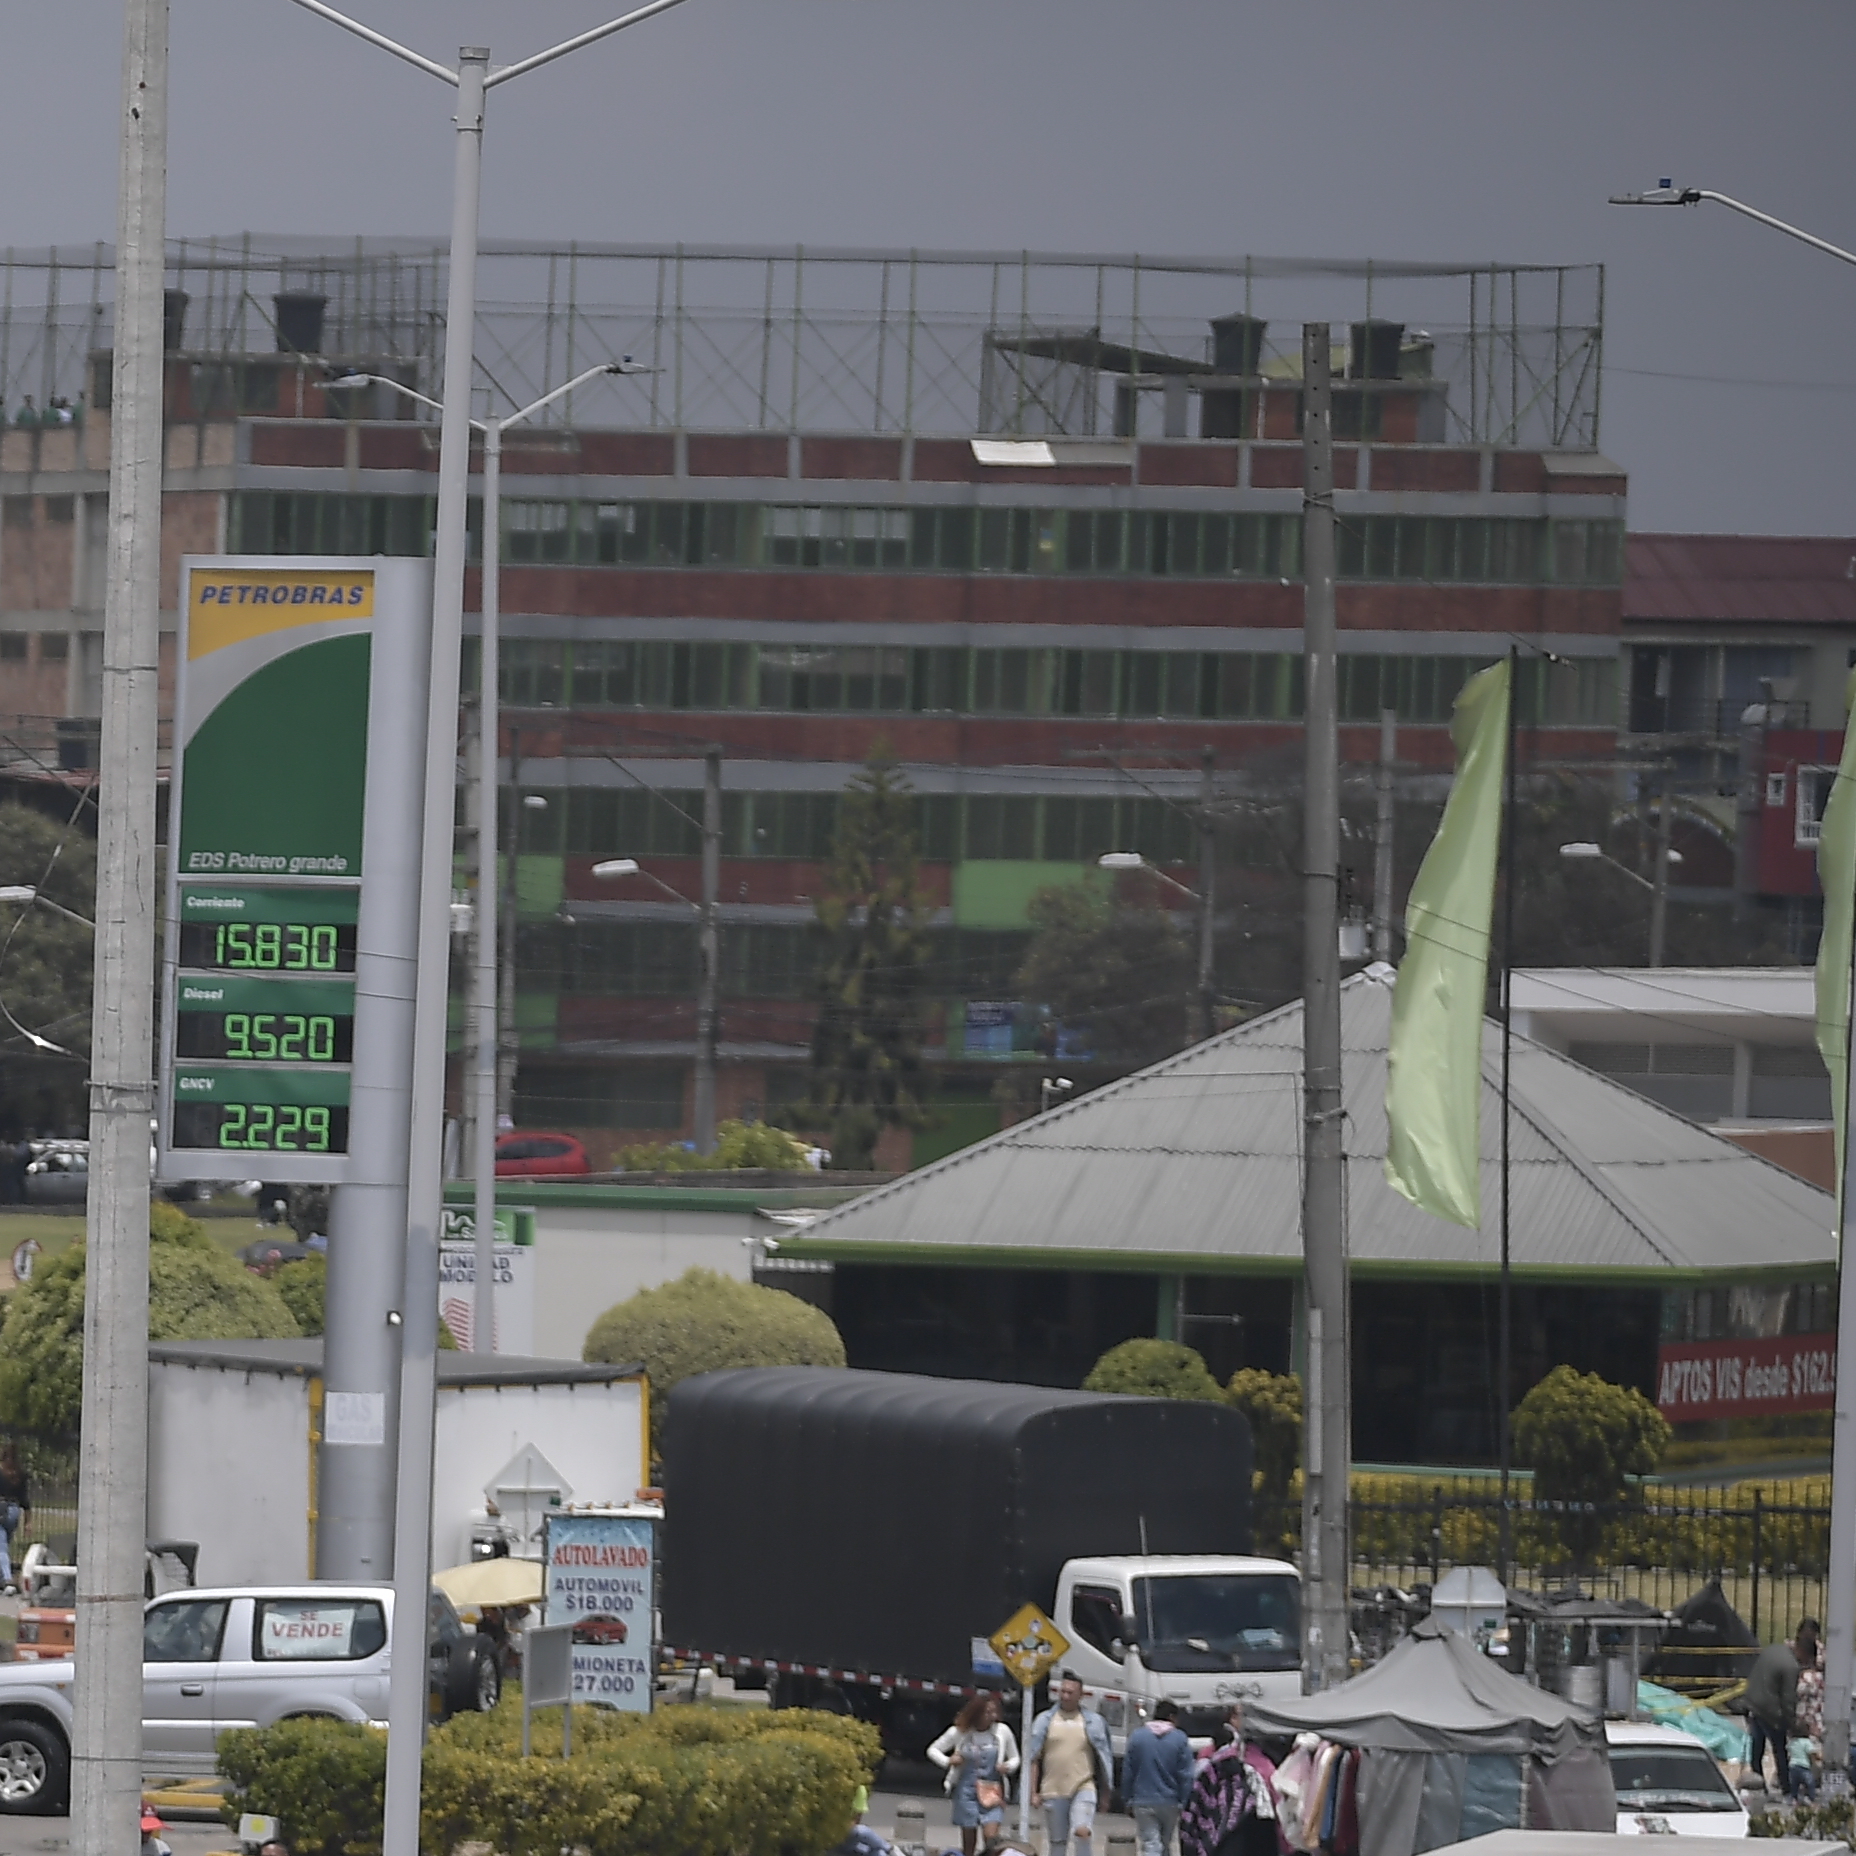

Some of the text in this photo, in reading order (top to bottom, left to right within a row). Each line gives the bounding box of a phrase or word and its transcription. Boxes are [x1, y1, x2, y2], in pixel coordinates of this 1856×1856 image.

[200, 586, 365, 604] PETROBRAS
[190, 852, 348, 874] EDS Potrero grande
[183, 987, 225, 999] Diesel
[442, 1257, 511, 1270] UNIAD
[1658, 1351, 1835, 1405] APTOS VIS desde $162.
[553, 1544, 648, 1568] AUTOLAVADO
[554, 1577, 644, 1594] AUTOMOVIL
[566, 1593, 634, 1612] $18.000
[300, 1610, 318, 1621] SE
[272, 1622, 344, 1638] VENDE
[572, 1656, 647, 1674] MIONETA
[572, 1675, 635, 1693] 27.000
